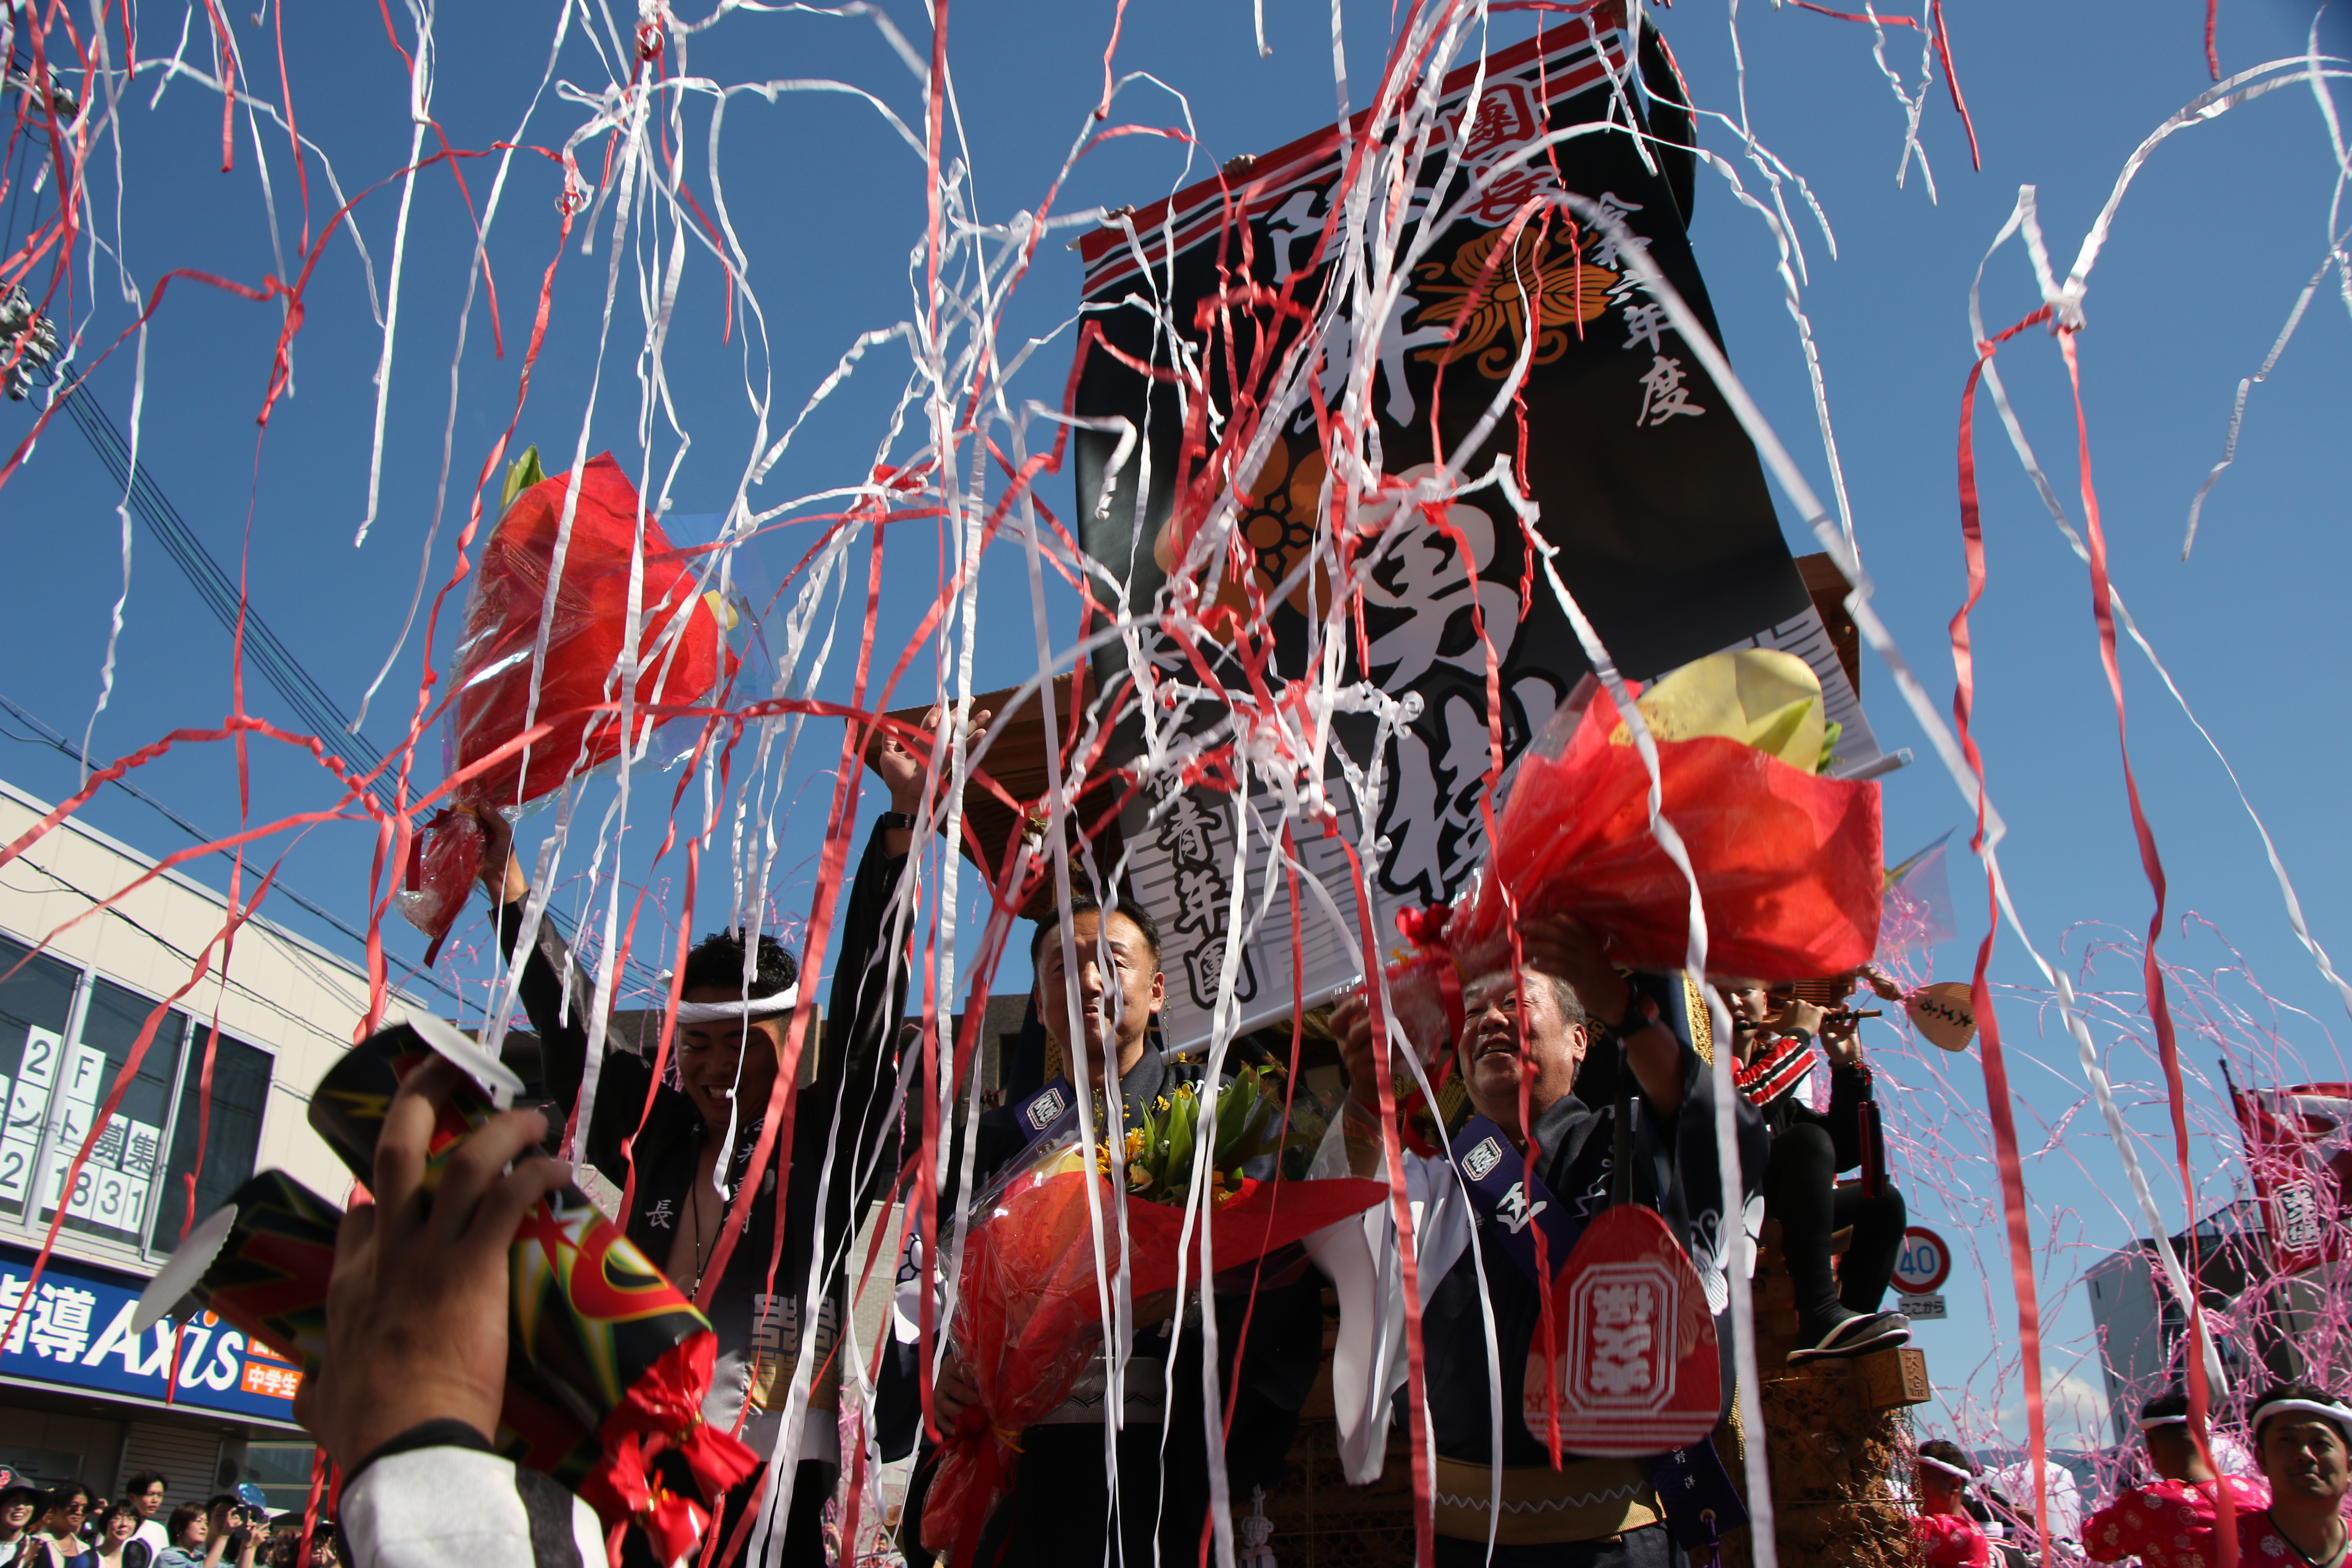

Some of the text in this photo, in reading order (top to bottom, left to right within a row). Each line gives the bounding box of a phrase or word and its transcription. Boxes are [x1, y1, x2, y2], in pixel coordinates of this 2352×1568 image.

[55, 1166, 142, 1224] 1831
[645, 1199, 674, 1229] 長
[1899, 1246, 1935, 1275] 40
[1901, 1301, 1945, 1315] ここから
[247, 1366, 297, 1396] 中学生
